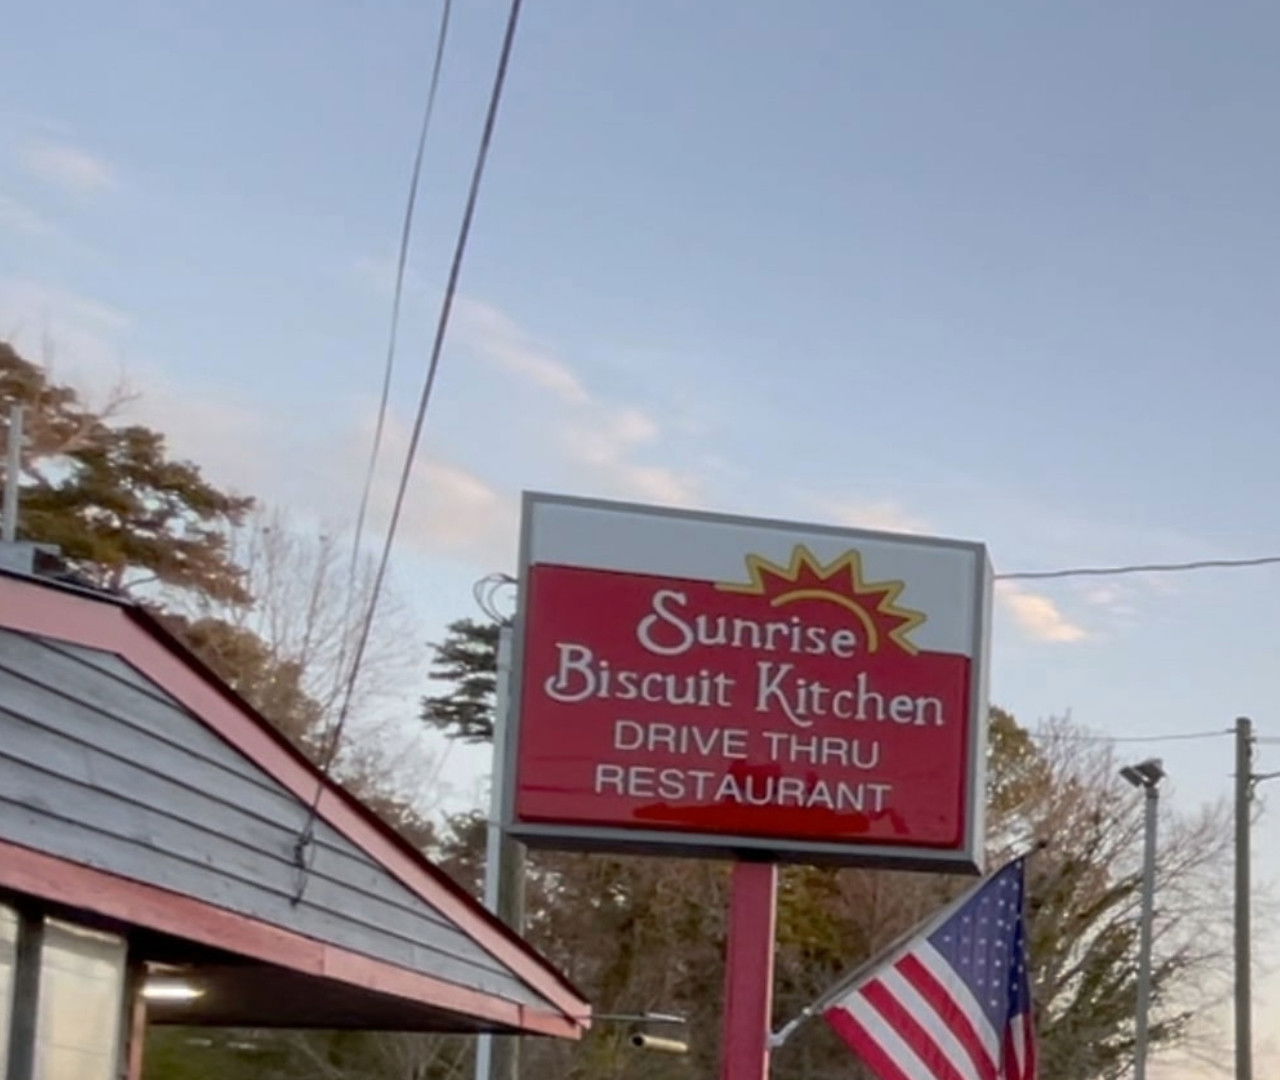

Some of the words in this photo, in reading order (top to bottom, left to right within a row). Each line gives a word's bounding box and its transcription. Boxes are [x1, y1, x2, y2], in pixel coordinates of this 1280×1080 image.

[637, 590, 857, 657] Sunrise
[544, 642, 736, 707] Biscuit
[755, 661, 945, 727] Kitchen
[613, 719, 749, 760] DRIVE
[762, 730, 880, 770] THRU
[594, 763, 893, 813] RESTAURANT
